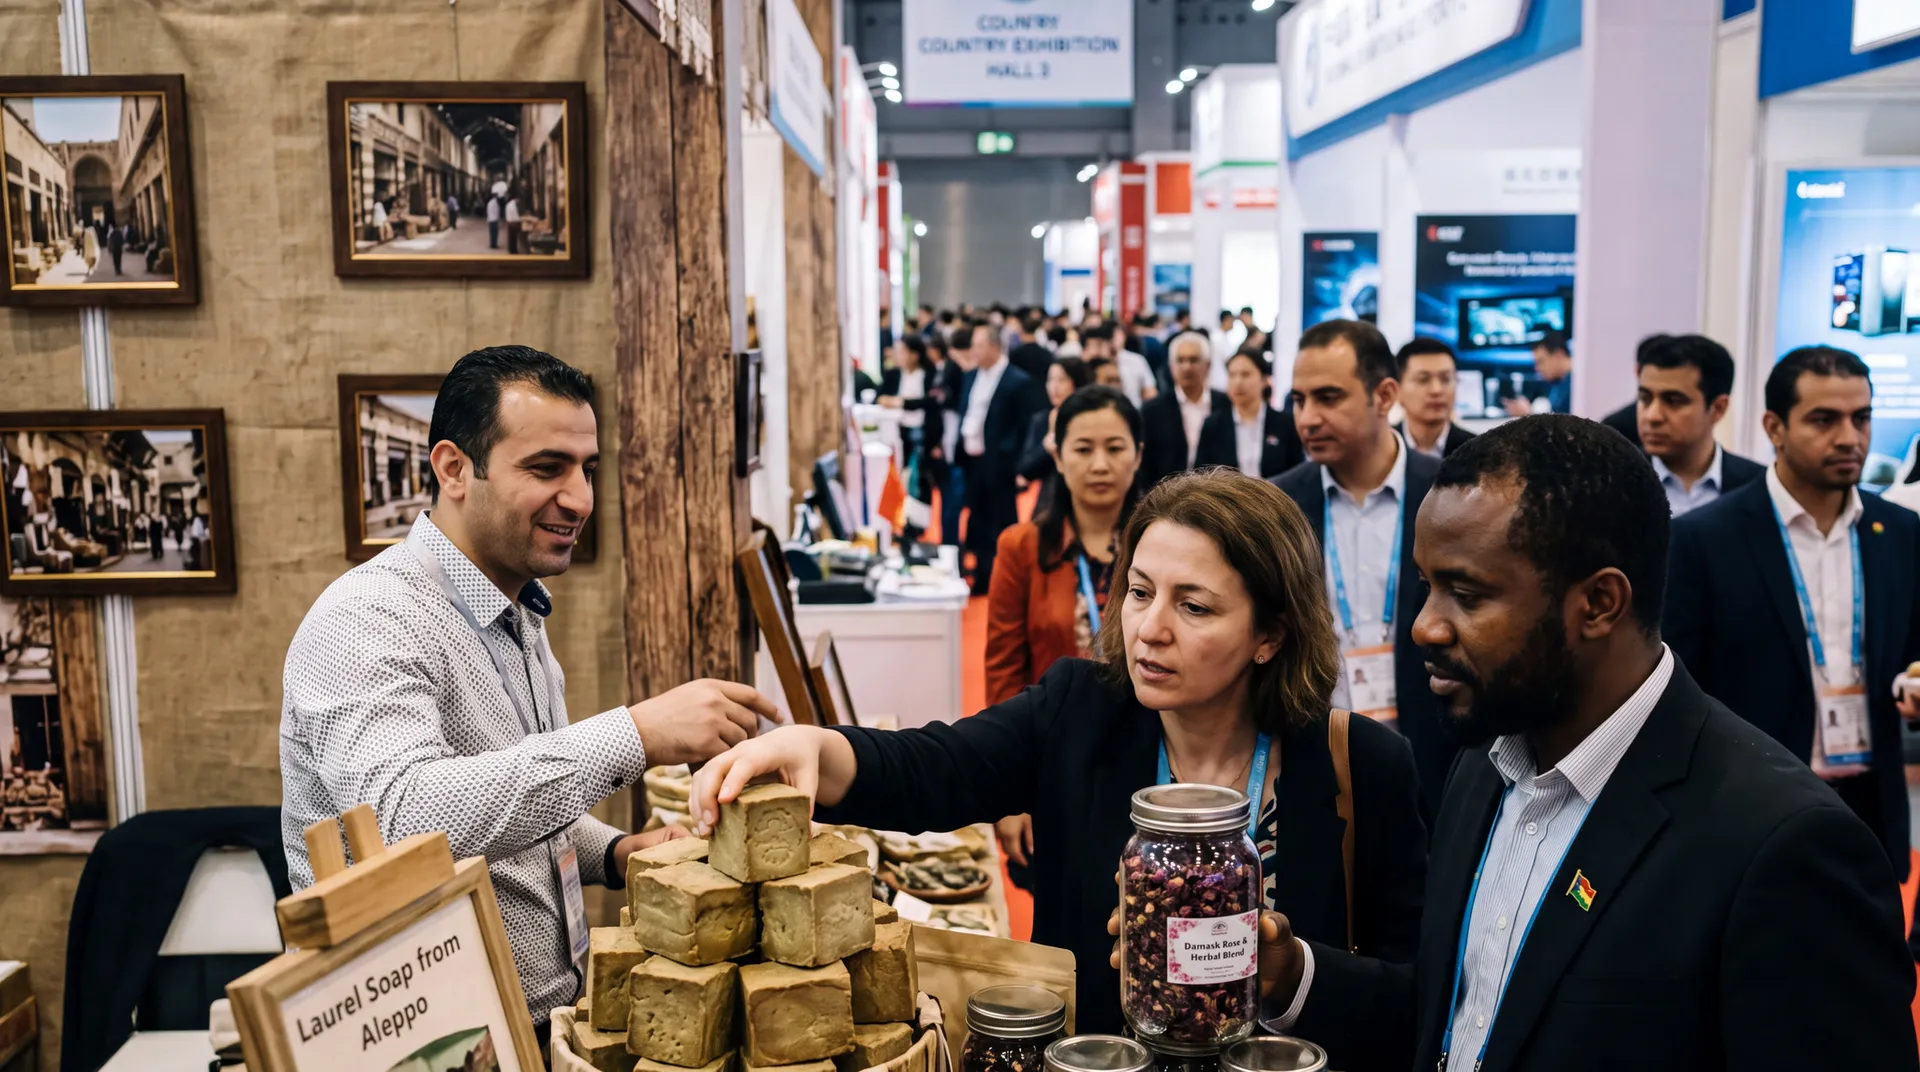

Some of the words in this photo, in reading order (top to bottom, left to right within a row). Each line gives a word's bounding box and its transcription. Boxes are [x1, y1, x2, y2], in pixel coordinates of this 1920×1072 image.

[977, 14, 1060, 31] COUNTRY
[918, 36, 1007, 54] COUNTRY
[1012, 36, 1119, 54] EXHIBITION
[1184, 941, 1220, 950] Damask
[1222, 940, 1240, 948] Rose
[1242, 936, 1248, 945] &
[1190, 952, 1221, 961] Herbal
[1222, 948, 1245, 960] Blend
[296, 985, 363, 1043] Laurel
[365, 962, 413, 1002] Soap
[416, 935, 461, 972] from
[362, 996, 429, 1052] Aleppo
